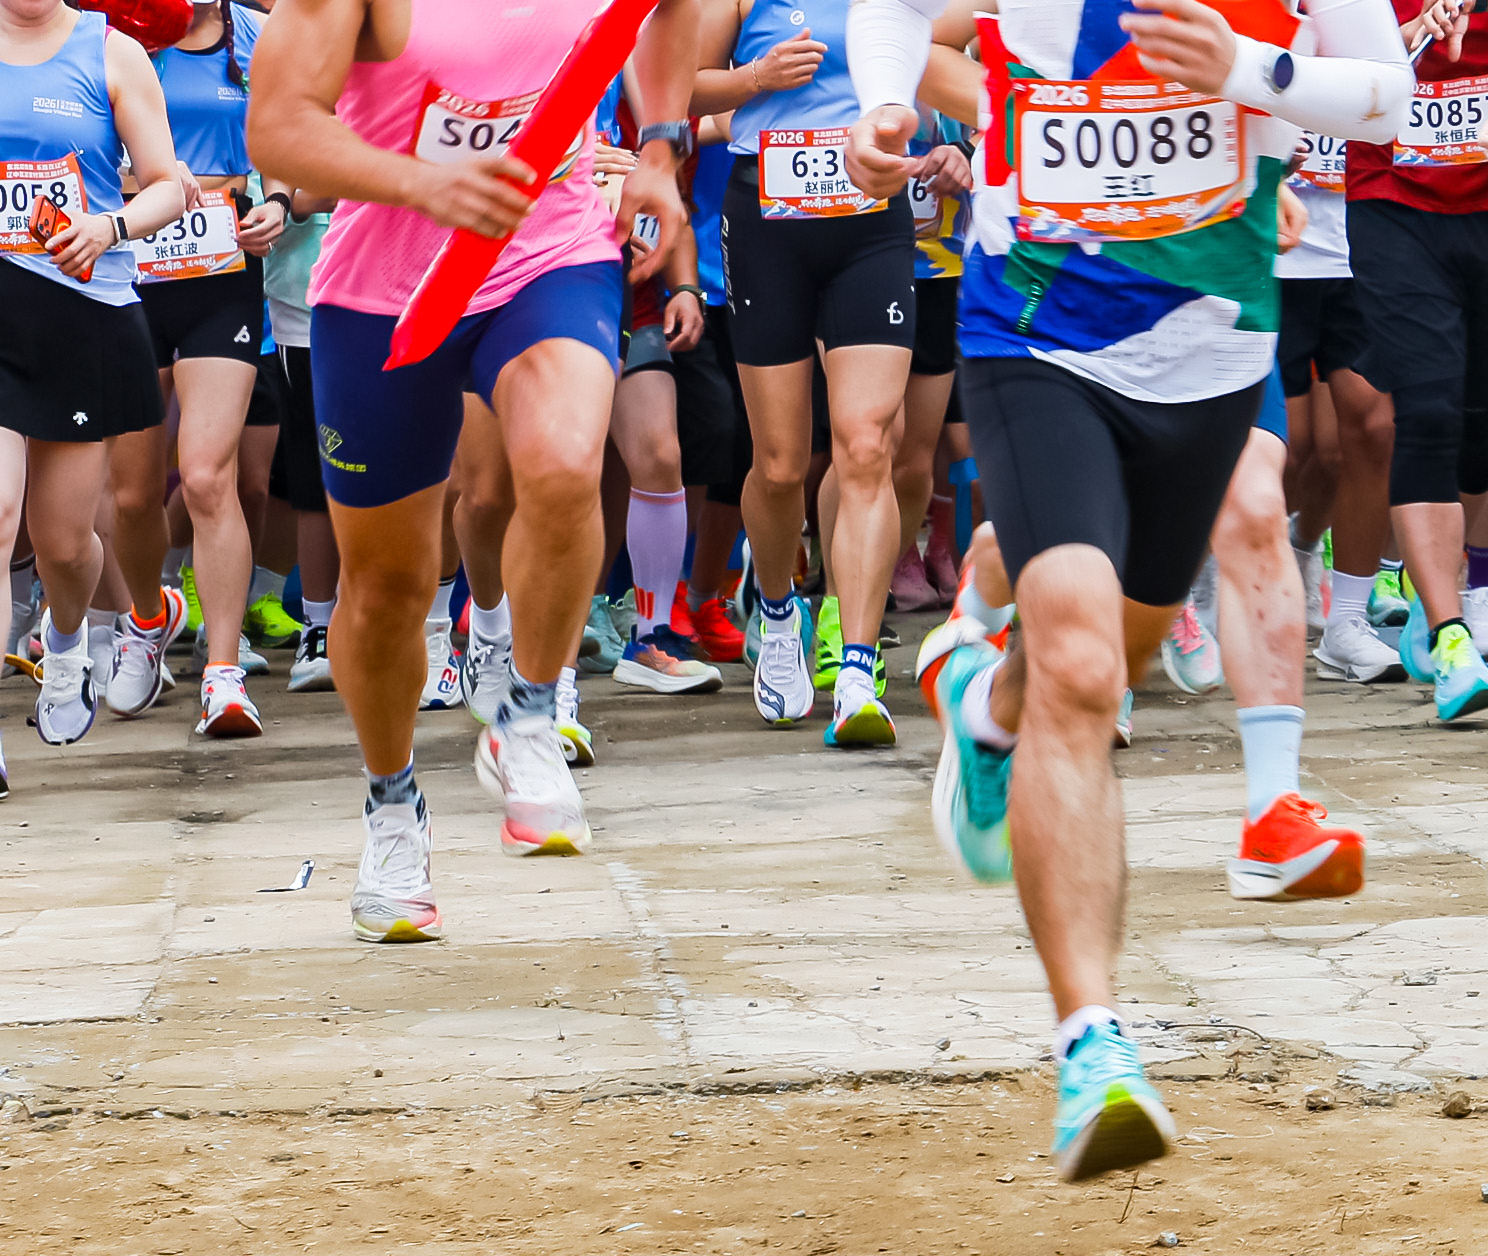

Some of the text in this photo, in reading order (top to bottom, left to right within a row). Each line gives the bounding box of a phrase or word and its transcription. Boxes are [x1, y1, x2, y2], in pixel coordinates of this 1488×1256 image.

[1028, 83, 1090, 107] 2026
[1410, 84, 1434, 95] 026
[33, 96, 57, 109] 2026
[769, 131, 805, 145] 2026
[1041, 110, 1214, 169] S0088
[1435, 128, 1479, 144] 张恒兵
[154, 242, 199, 259] 张红波
